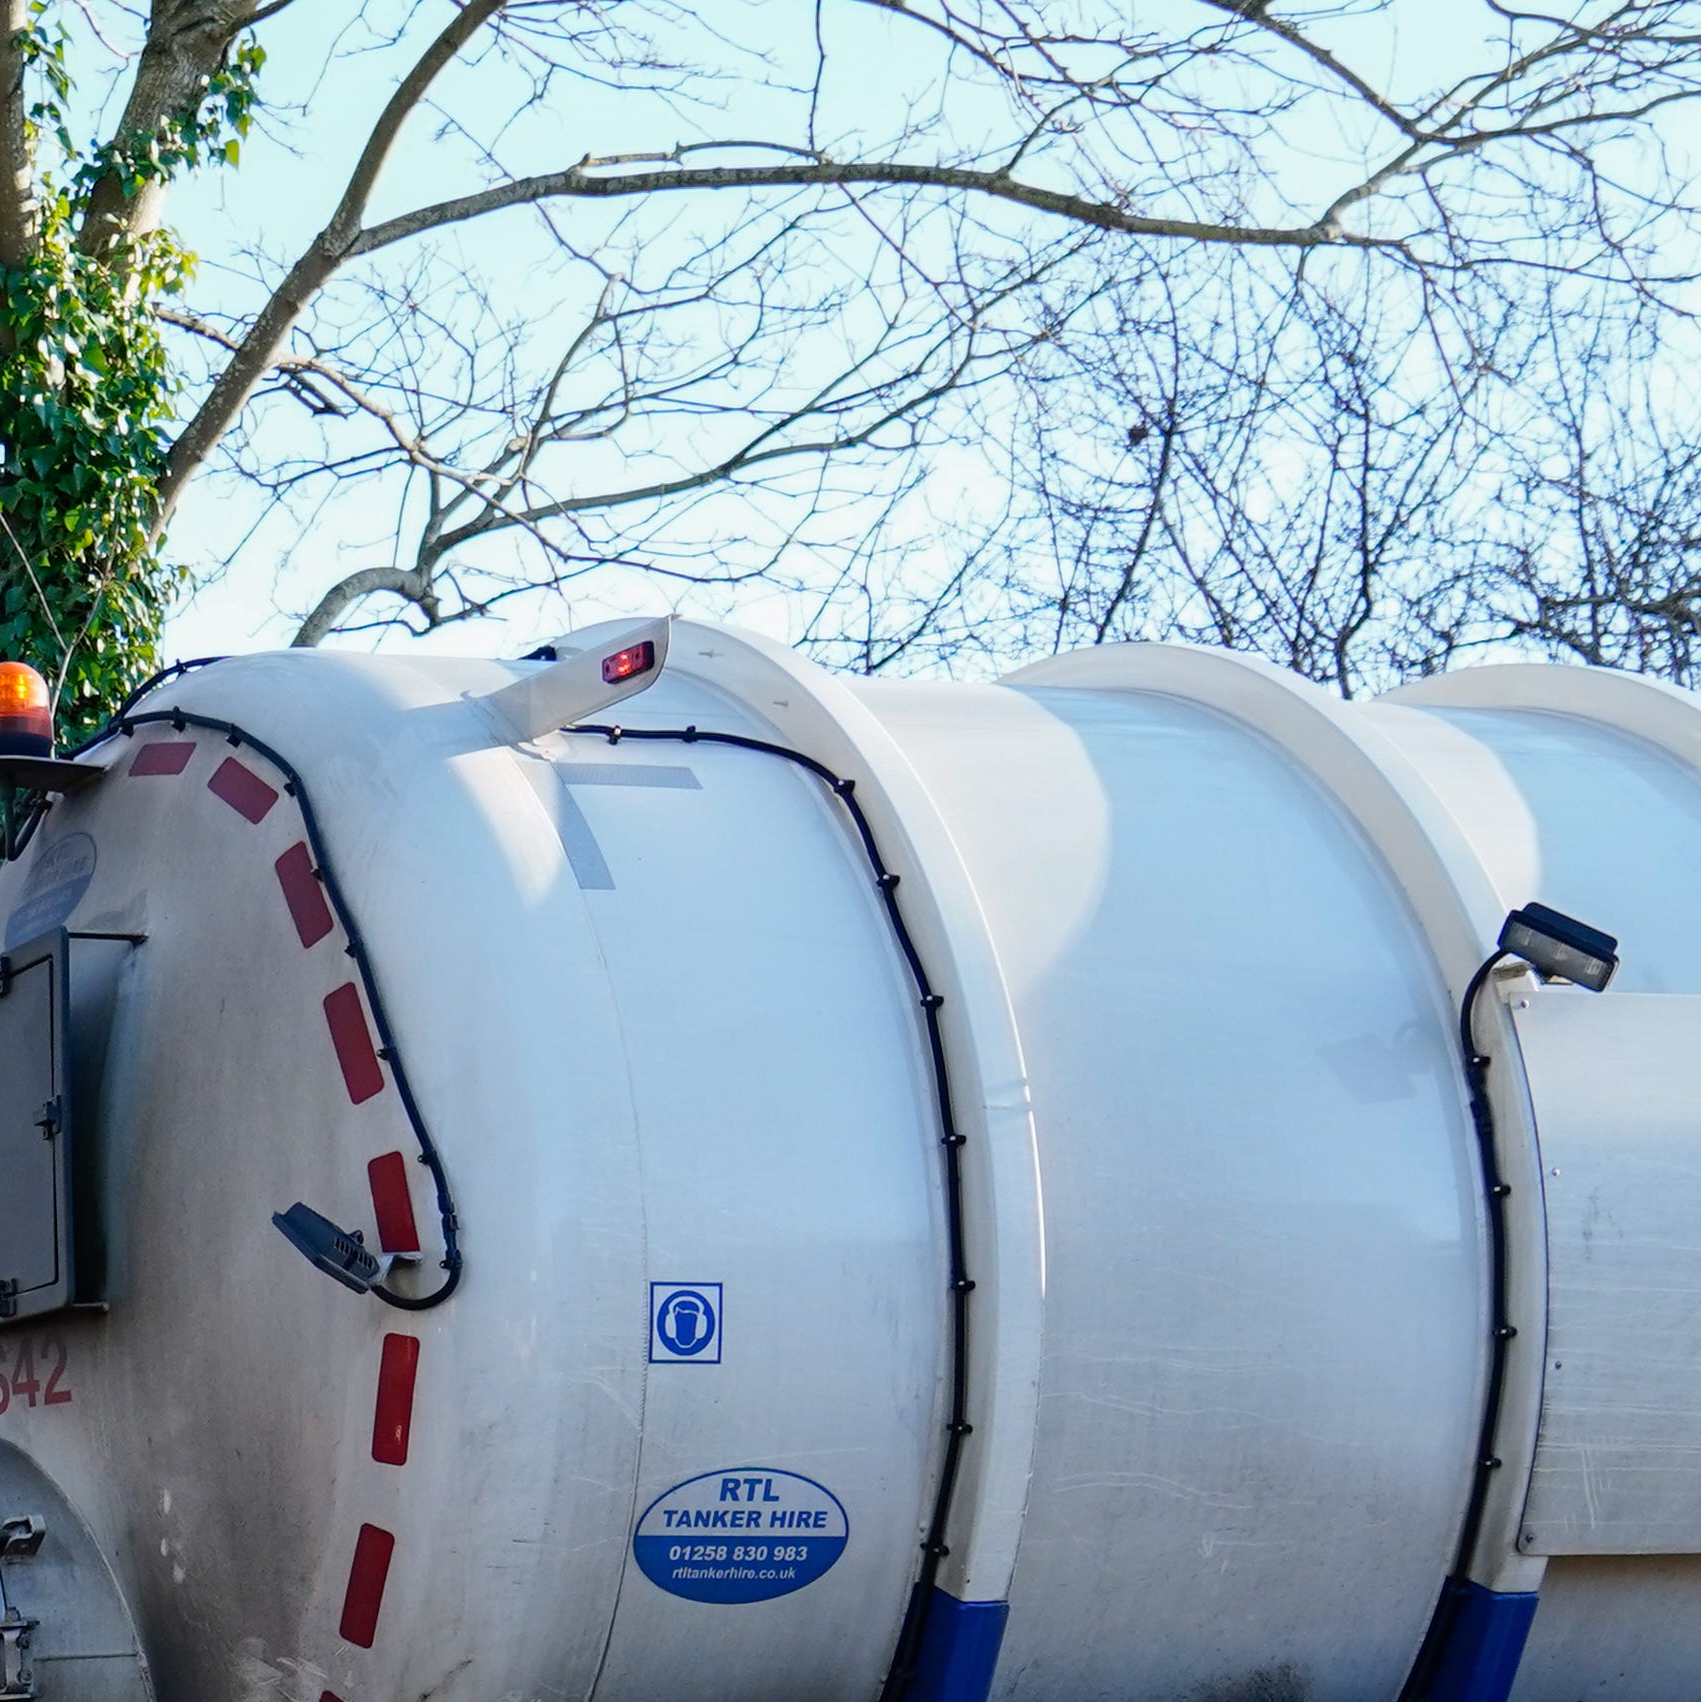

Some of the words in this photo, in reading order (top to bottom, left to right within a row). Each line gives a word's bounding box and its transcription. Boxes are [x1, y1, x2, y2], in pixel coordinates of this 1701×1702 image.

[719, 1478, 780, 1502] RTL
[663, 1510, 762, 1528] TANKER
[770, 1510, 828, 1528] HIRE
[668, 1545, 727, 1562] 01258
[732, 1545, 769, 1562] 830
[772, 1545, 809, 1562] 983
[672, 1567, 796, 1580] rtltankerhire.co.uk
